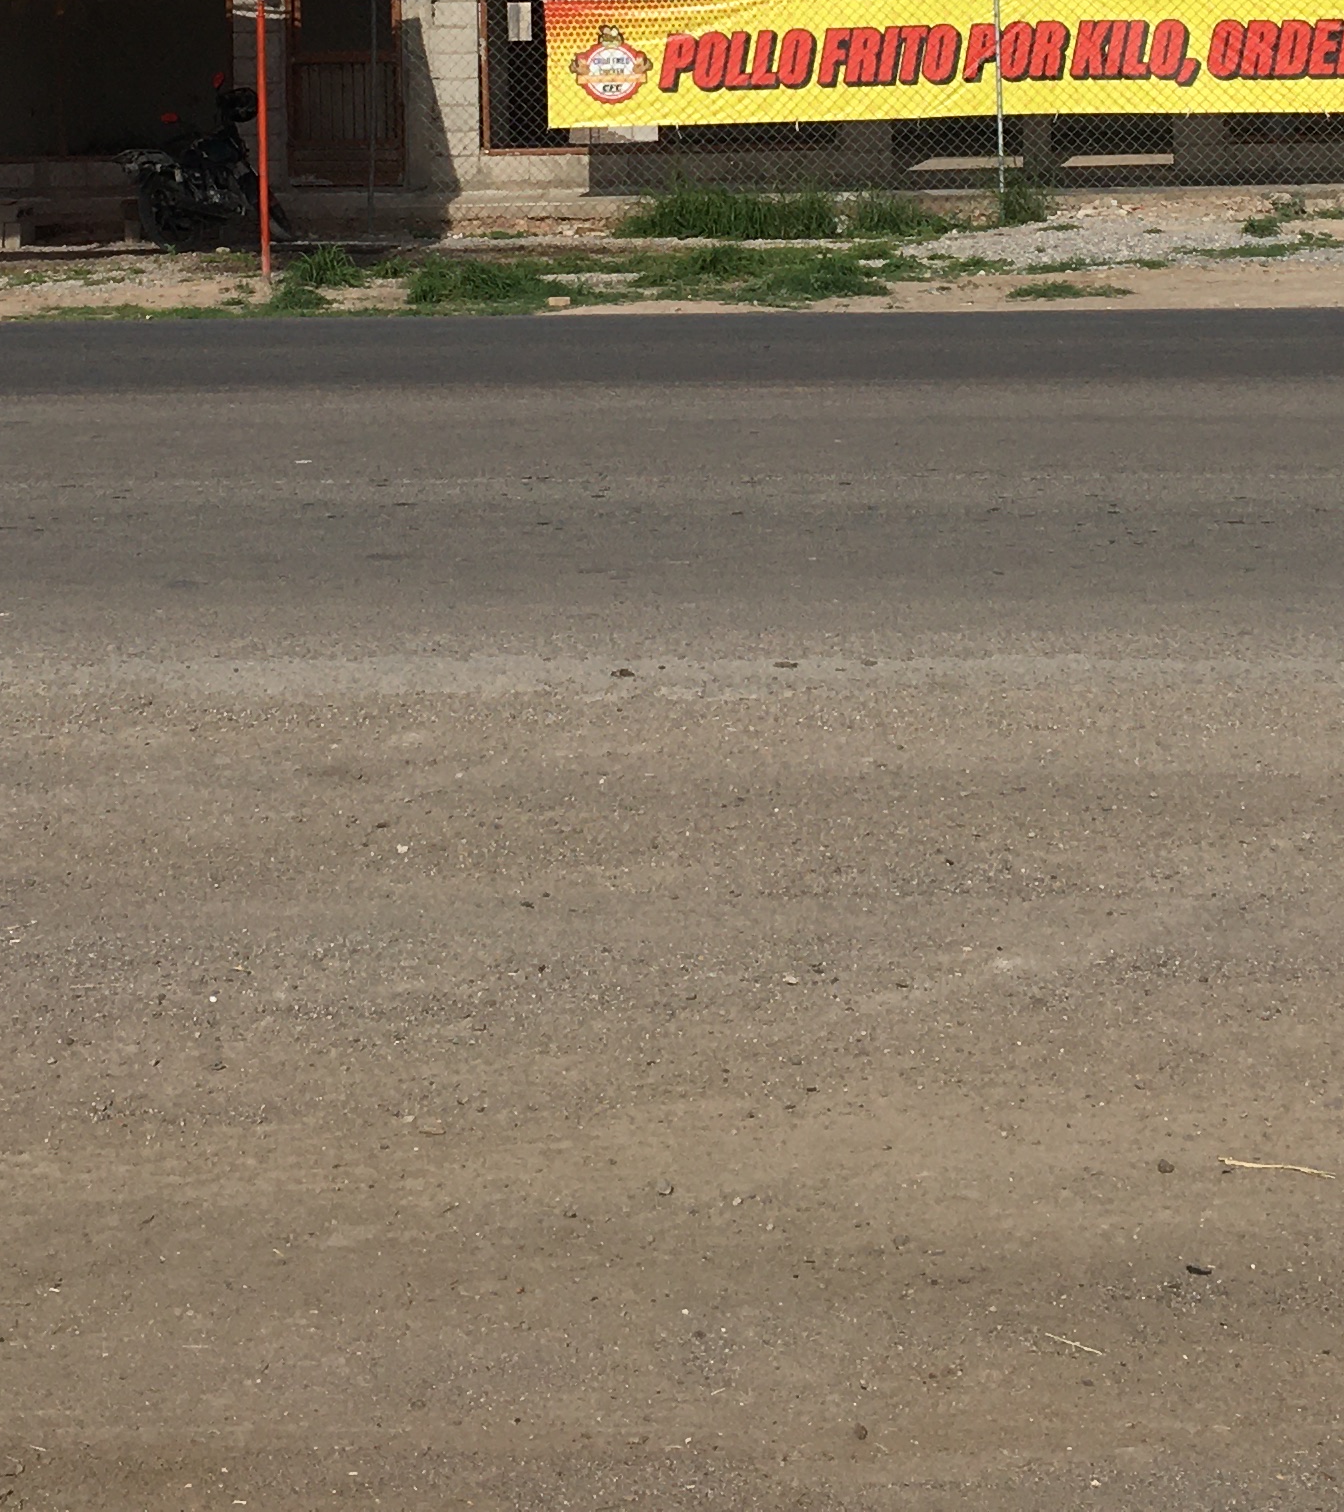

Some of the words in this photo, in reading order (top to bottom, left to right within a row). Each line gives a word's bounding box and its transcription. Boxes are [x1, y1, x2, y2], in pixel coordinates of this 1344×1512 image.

[658, 28, 817, 93] POLLO
[817, 24, 963, 89] FRITO
[962, 20, 1071, 83] POR
[1070, 18, 1201, 87] KILO,
